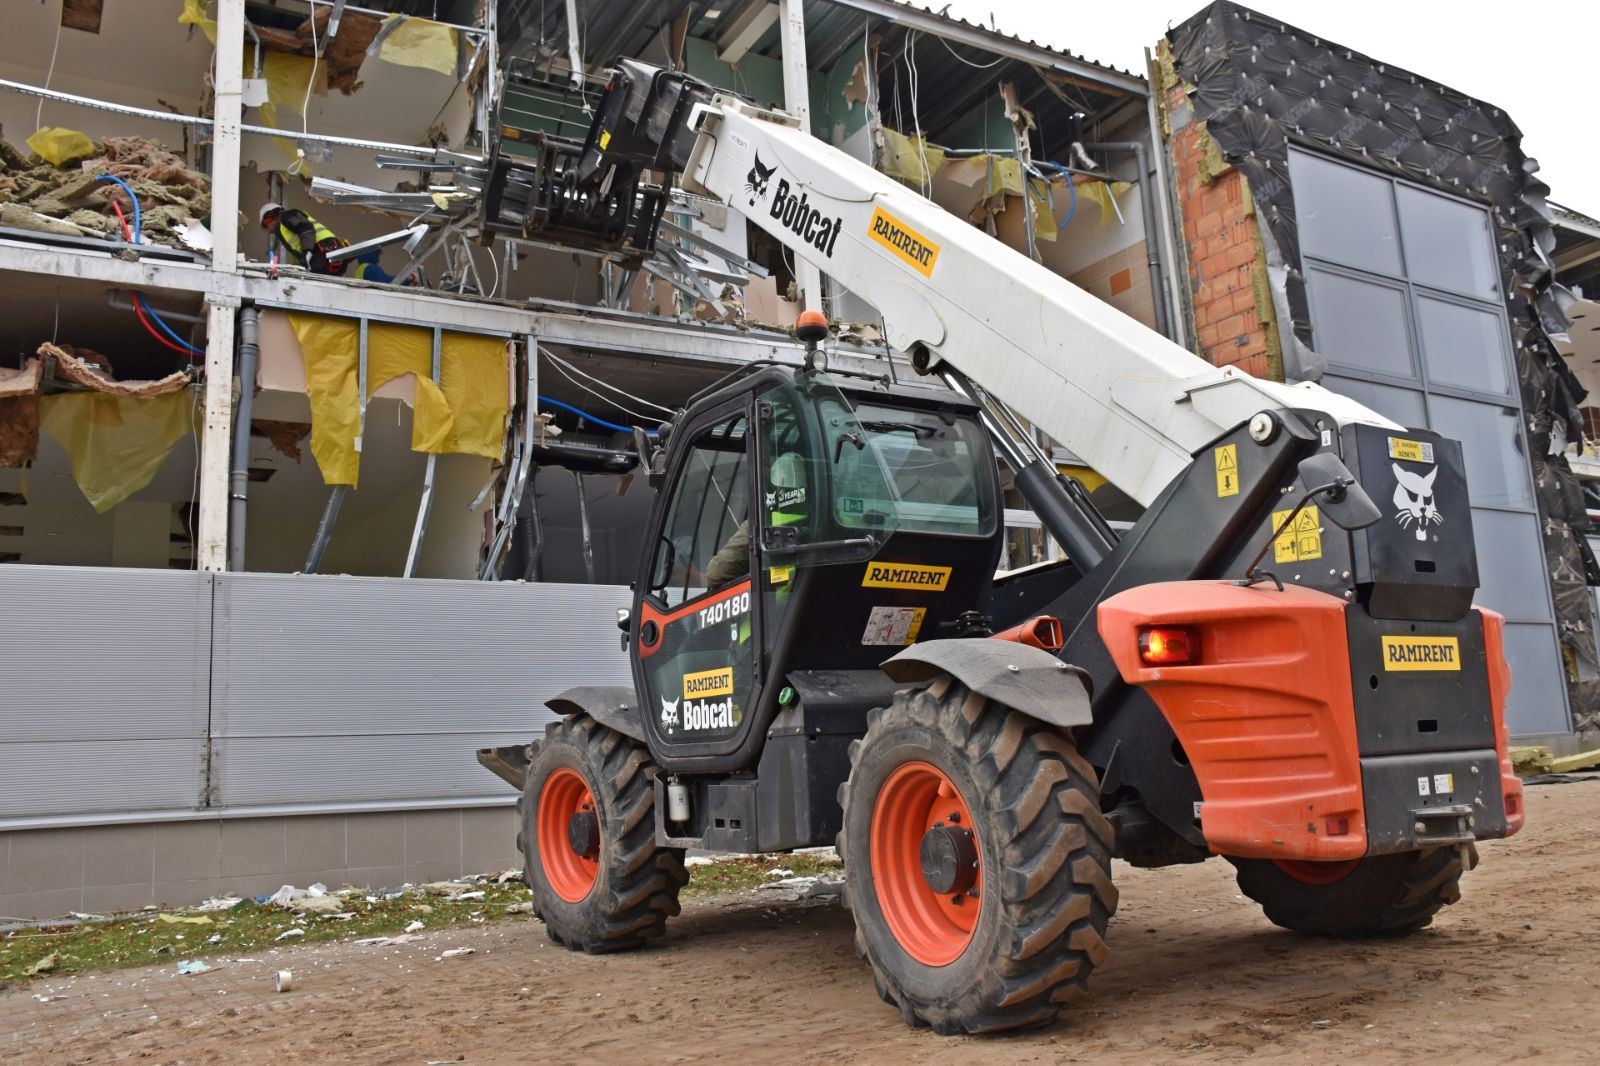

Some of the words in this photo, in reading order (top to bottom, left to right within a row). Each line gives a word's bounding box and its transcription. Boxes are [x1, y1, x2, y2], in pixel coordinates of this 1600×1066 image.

[770, 178, 842, 259] Bobcat
[873, 216, 933, 267] RAMIRENT
[869, 568, 945, 585] RAMIRENT
[700, 592, 749, 629] T40180
[1388, 644, 1454, 663] RAMIRENT
[687, 674, 729, 693] RAMIRENT
[683, 697, 733, 731] Bobcat
